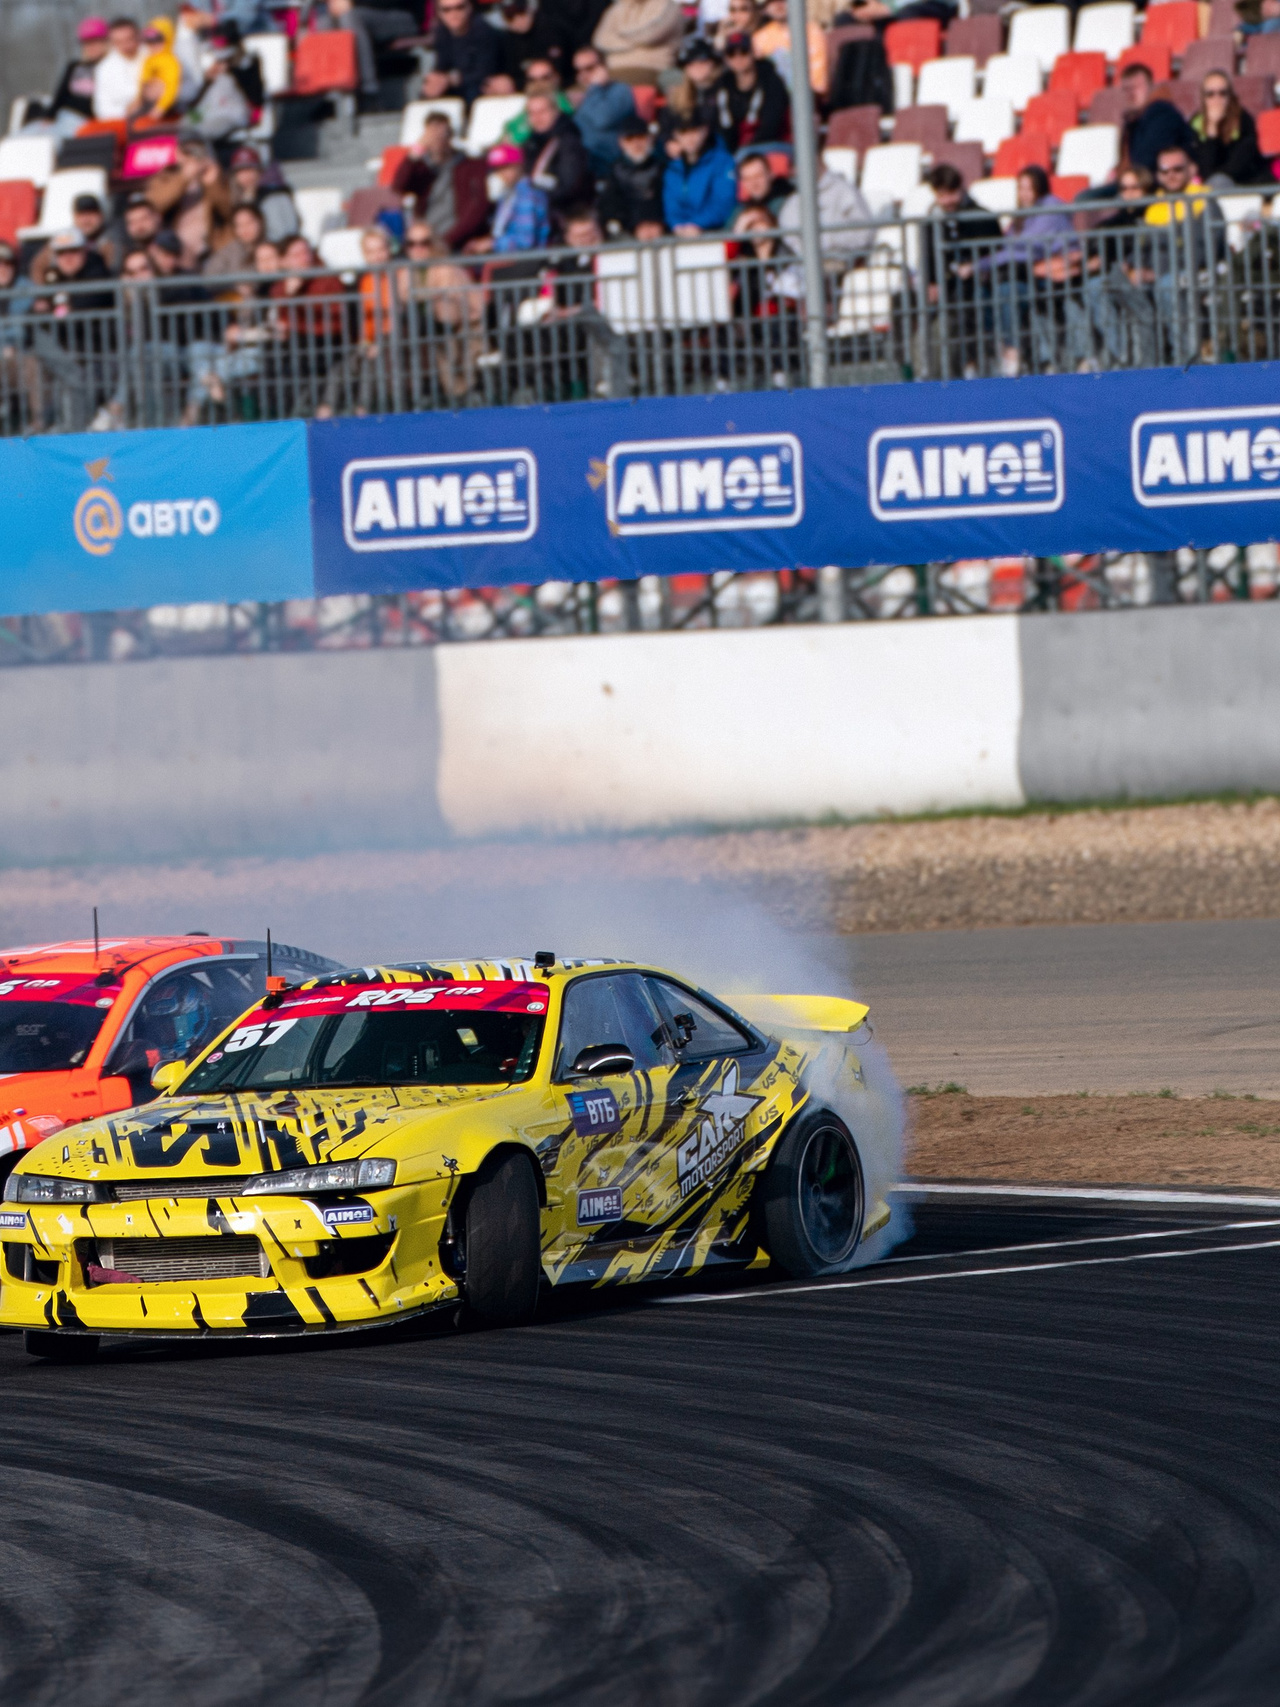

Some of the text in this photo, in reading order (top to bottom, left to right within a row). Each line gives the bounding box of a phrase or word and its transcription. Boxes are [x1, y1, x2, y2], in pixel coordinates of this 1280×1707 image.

[878, 441, 1054, 502] AIMOL
[1142, 427, 1280, 486] AIMO
[354, 470, 527, 532] AIMOL
[618, 455, 793, 515] AIMOL
[345, 987, 447, 1007] RDS
[224, 1018, 298, 1053] 57
[585, 1097, 616, 1125] ВТБ
[680, 1120, 745, 1198] MOTORSPORT
[0, 1215, 24, 1226] AIMOL
[327, 1210, 370, 1222] AIMOL
[579, 1194, 621, 1219] AIMOL
